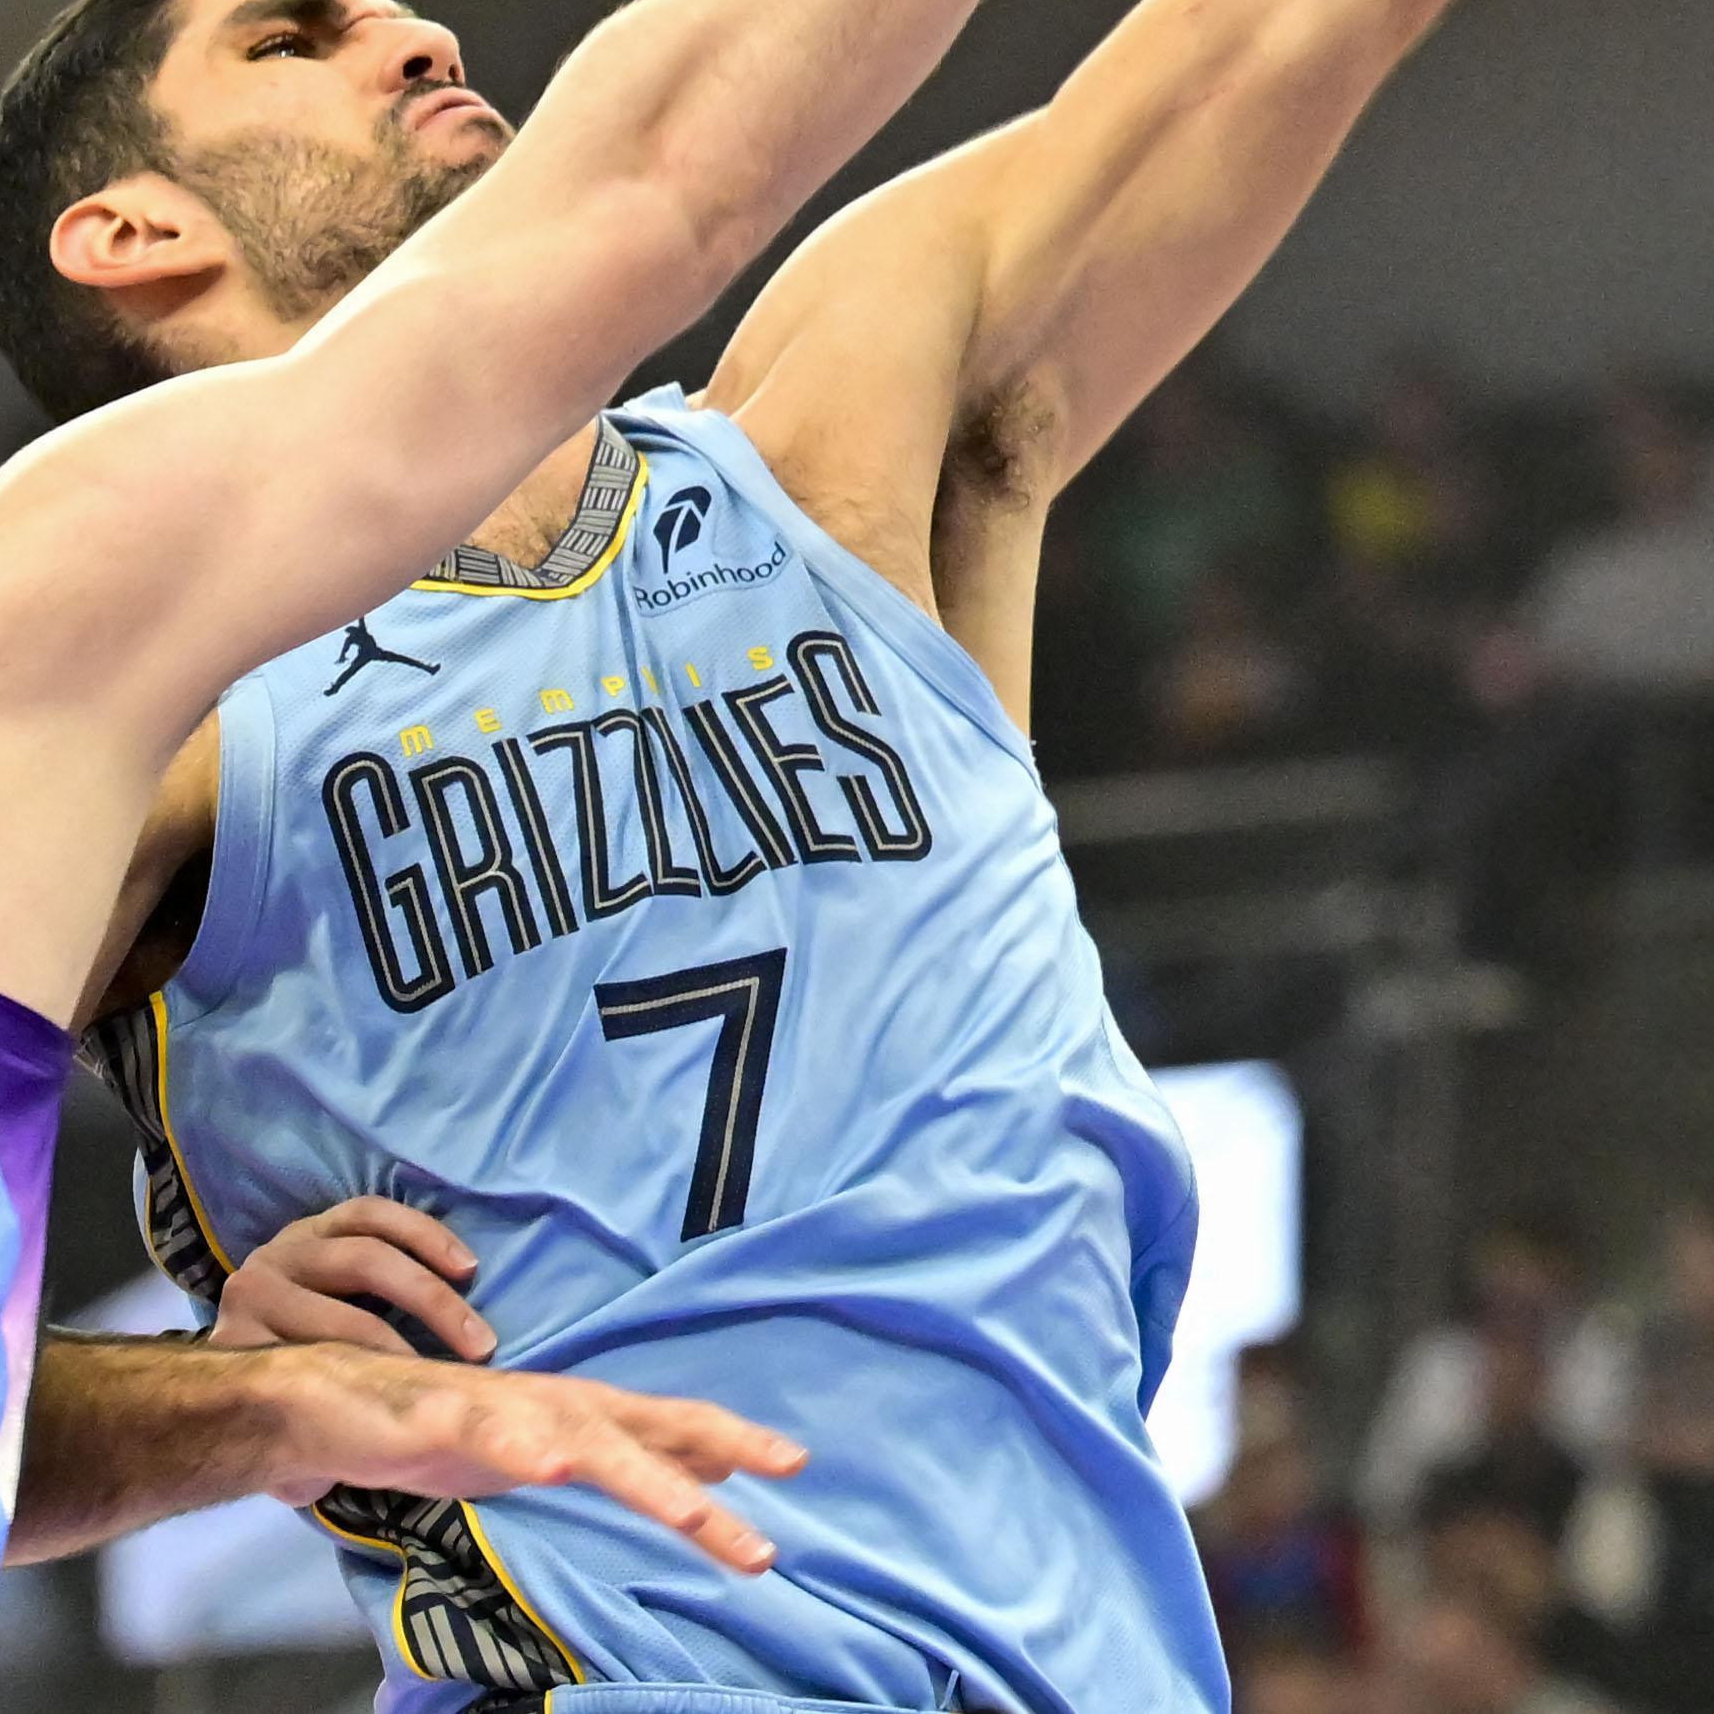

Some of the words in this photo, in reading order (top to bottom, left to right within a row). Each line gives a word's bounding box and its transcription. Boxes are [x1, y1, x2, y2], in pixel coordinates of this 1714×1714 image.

[633, 540, 787, 610] Robinhood
[322, 629, 934, 1015] GRIZZLIES
[593, 947, 788, 1244] 7
